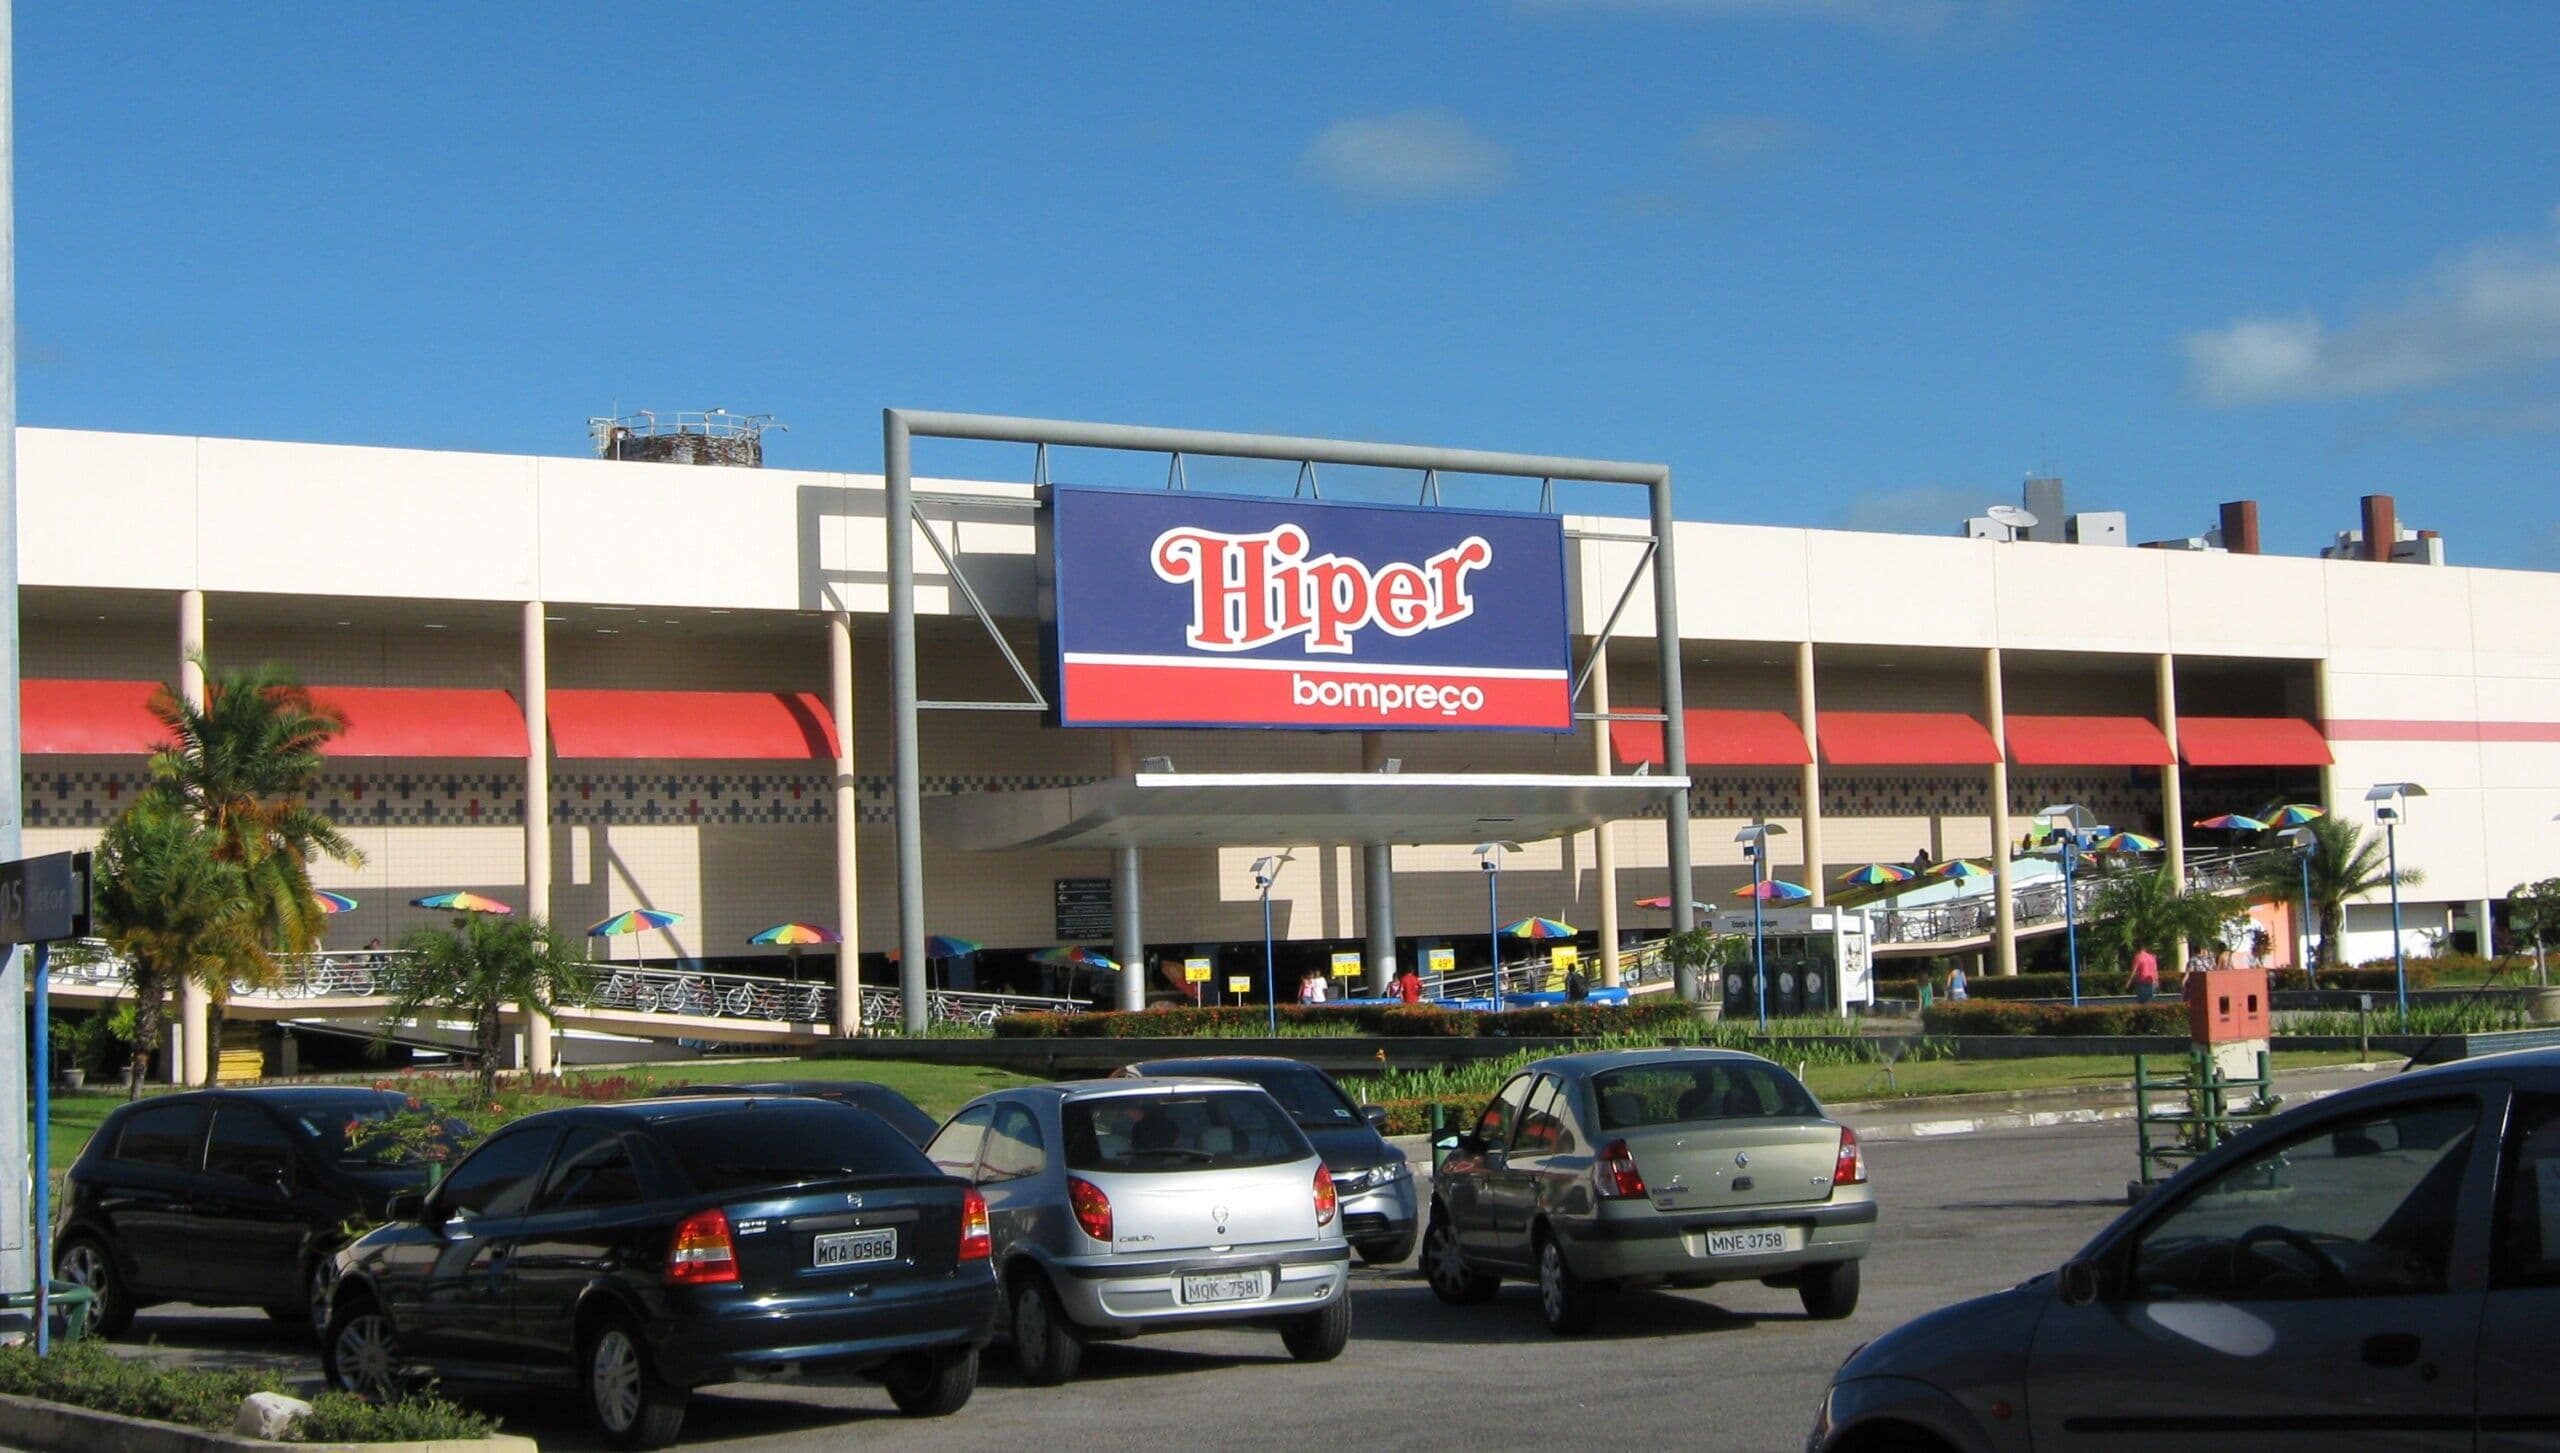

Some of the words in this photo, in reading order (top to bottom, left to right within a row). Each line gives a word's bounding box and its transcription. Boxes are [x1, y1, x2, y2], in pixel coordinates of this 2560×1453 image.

[1152, 524, 1491, 653] Hiper
[1293, 672, 1484, 716] bompreço
[1712, 1235, 1745, 1251] MNE
[1748, 1233, 1782, 1249] 3758
[1188, 1282, 1220, 1299] MQK
[1228, 1279, 1260, 1297] 7581
